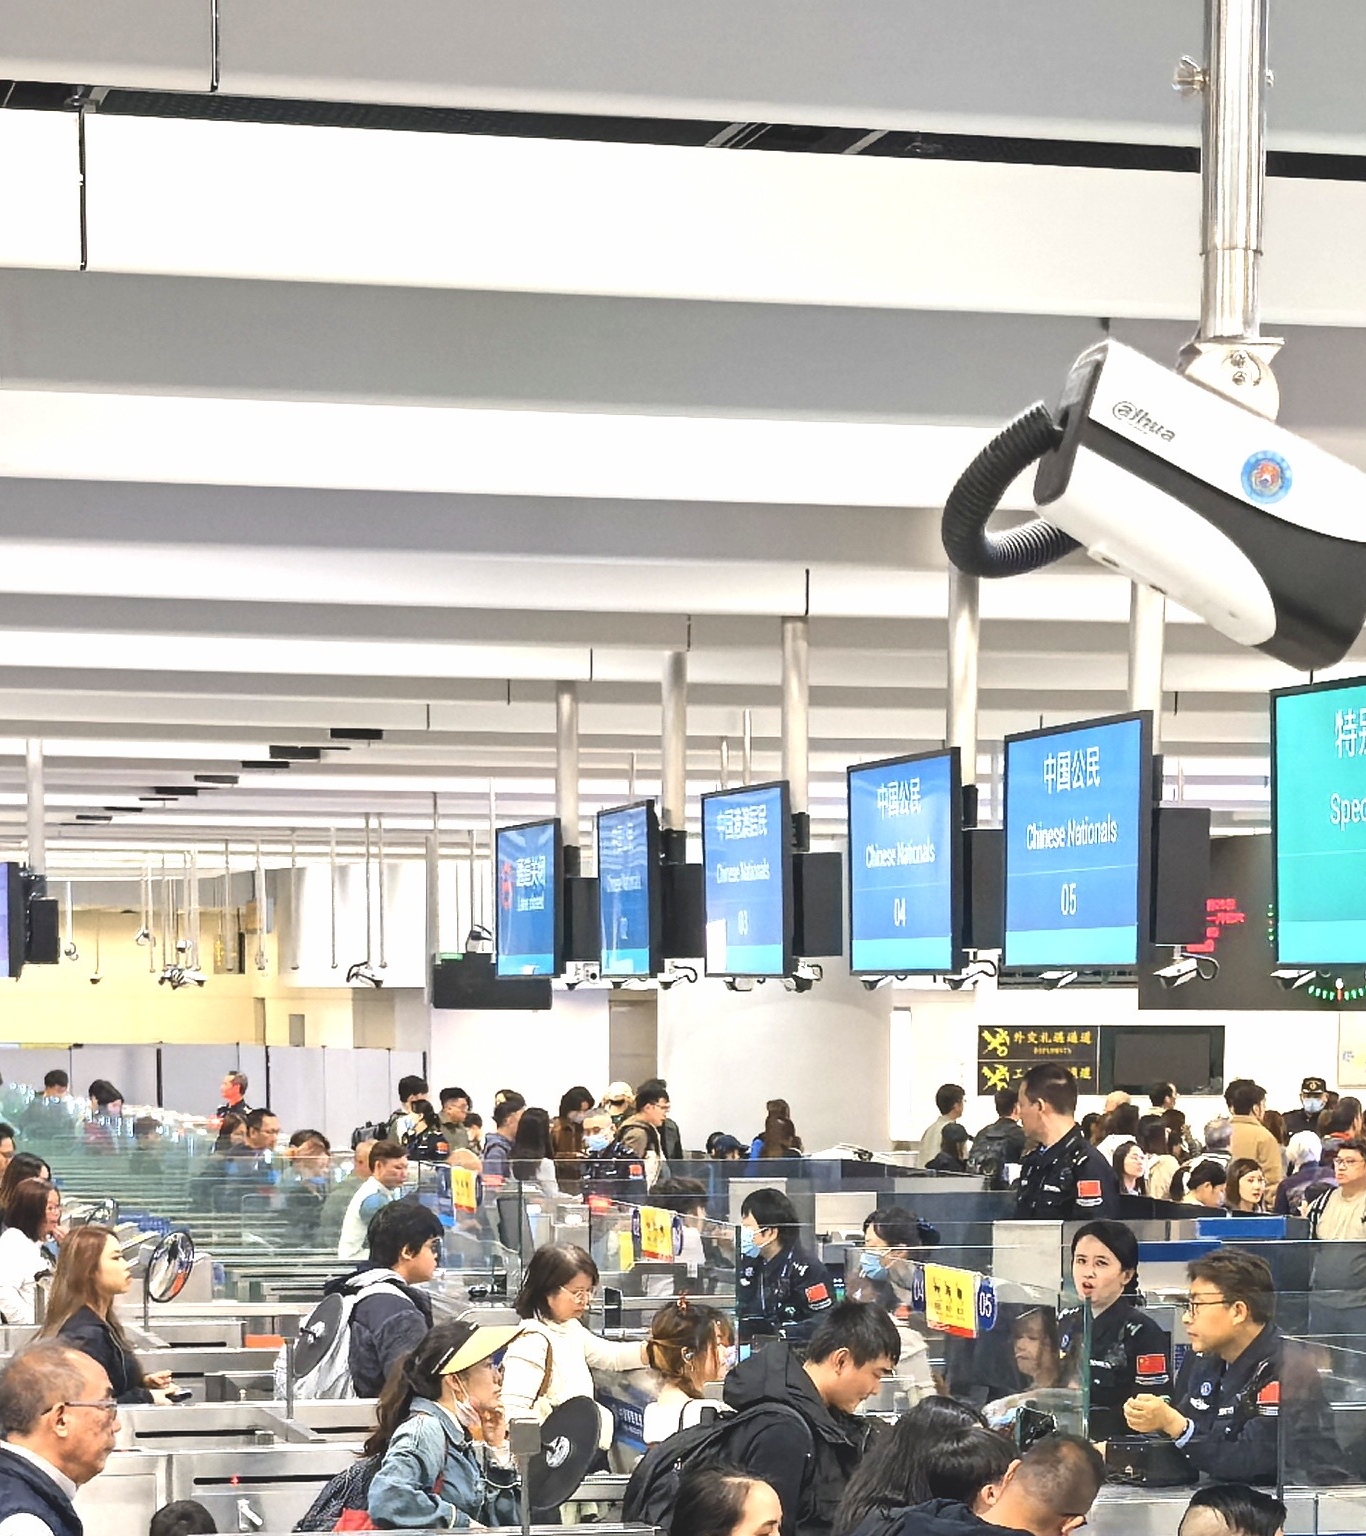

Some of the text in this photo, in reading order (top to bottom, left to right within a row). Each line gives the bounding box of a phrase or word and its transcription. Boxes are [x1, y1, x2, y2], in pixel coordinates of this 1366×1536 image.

[1043, 746, 1100, 794] 中国公民
[877, 778, 921, 819] 中国公民
[1026, 813, 1117, 851] Chinese Nationals
[865, 836, 935, 868] Chinese Nationals
[893, 898, 906, 926] 04
[1060, 883, 1077, 915] 05
[979, 1292, 992, 1317] 05
